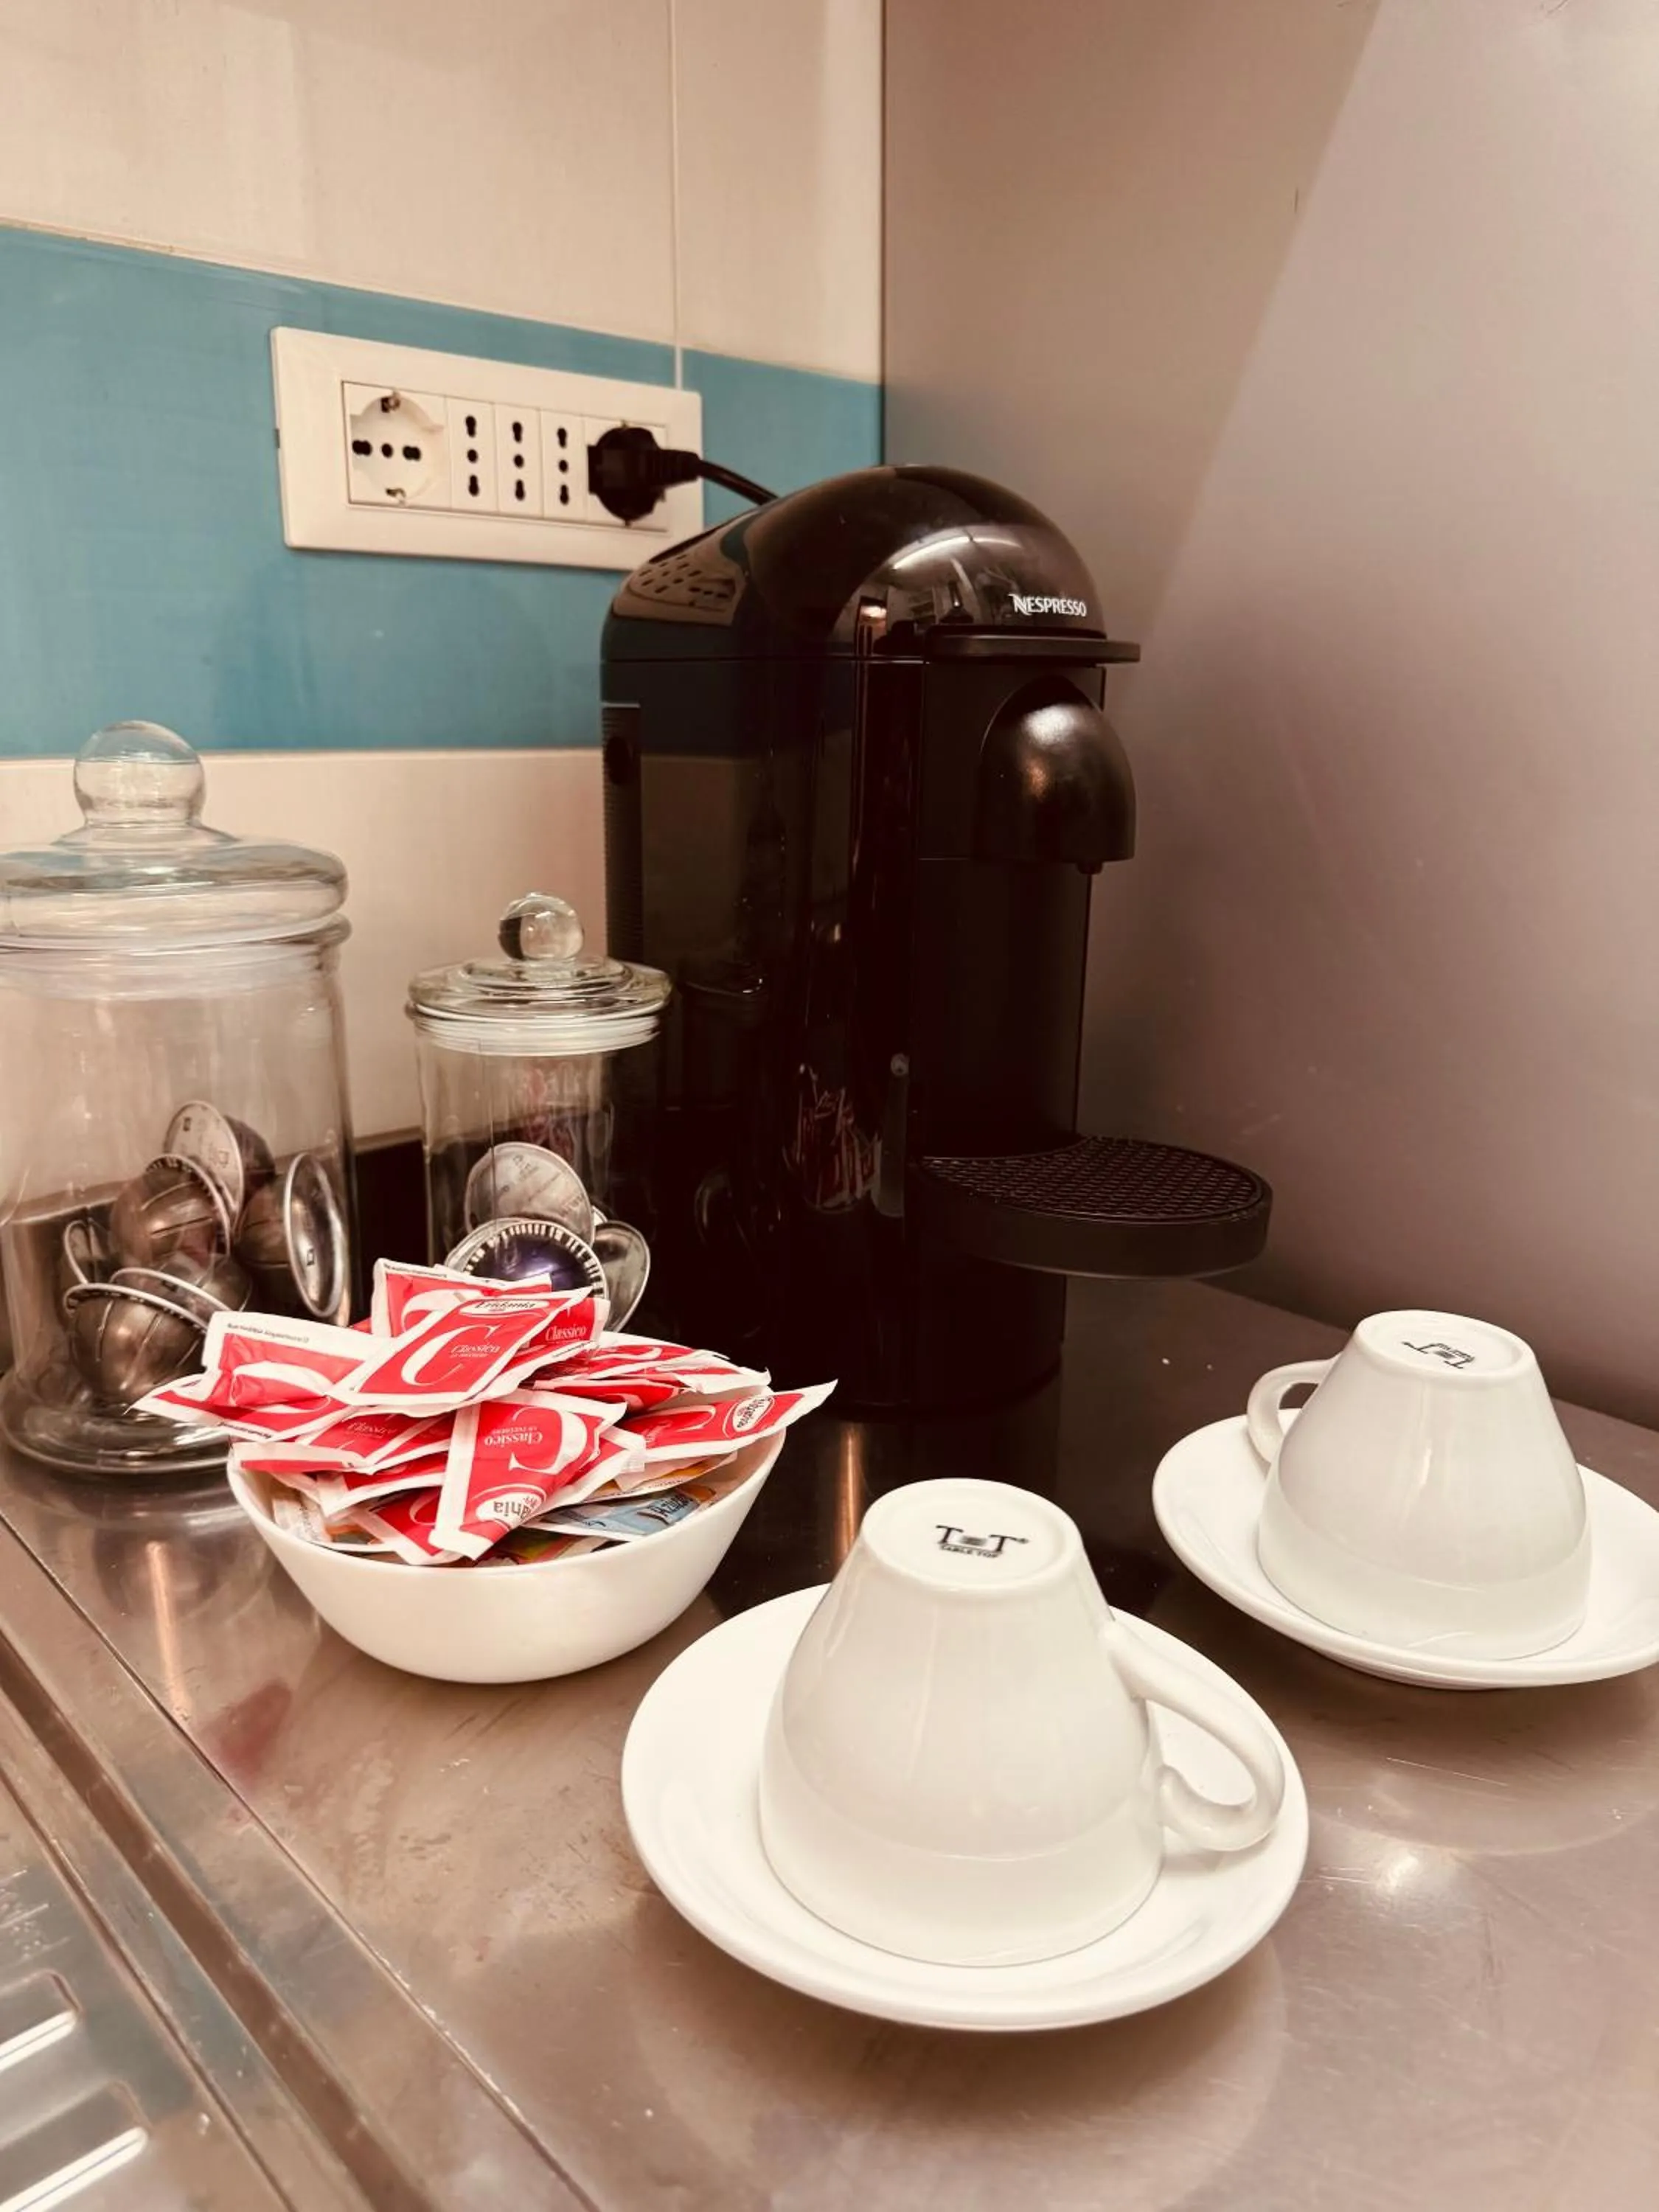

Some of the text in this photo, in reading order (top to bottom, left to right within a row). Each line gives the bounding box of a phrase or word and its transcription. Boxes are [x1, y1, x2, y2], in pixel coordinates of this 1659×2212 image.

[1008, 593, 1088, 617] NESPRESSO
[546, 1324, 587, 1341] Classico
[484, 1430, 543, 1448] Classico
